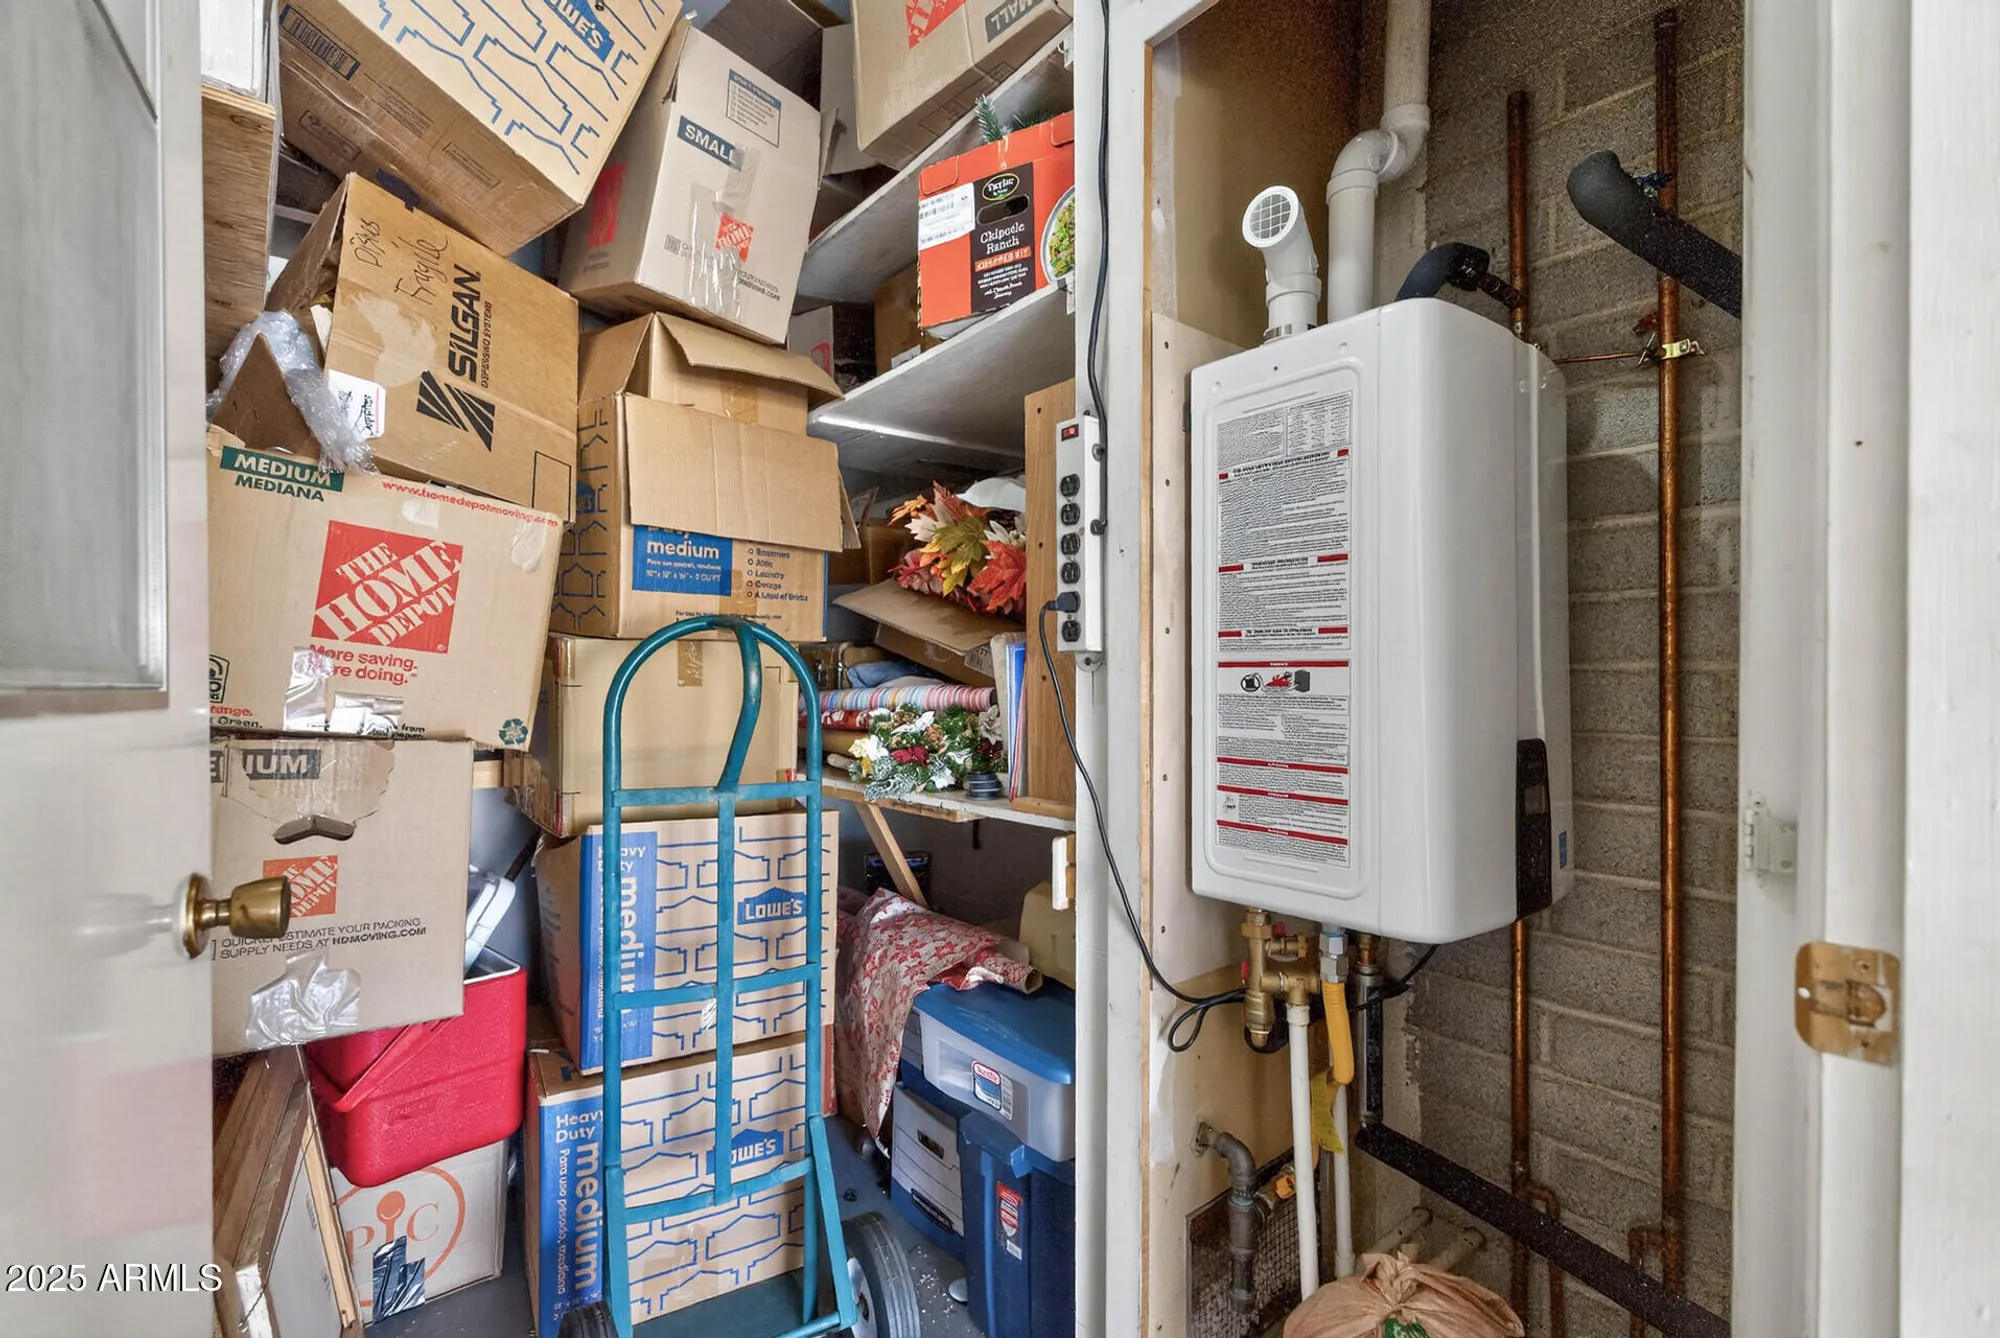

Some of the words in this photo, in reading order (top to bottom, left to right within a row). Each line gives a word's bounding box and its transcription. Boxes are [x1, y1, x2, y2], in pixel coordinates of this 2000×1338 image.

[990, 0, 1035, 31] MALL
[684, 124, 737, 164] SMALL
[986, 235, 1020, 255] Ranch
[448, 263, 481, 383] SILGAN
[233, 453, 332, 486] MEDIUM
[234, 474, 325, 502] MEDIANA
[334, 542, 398, 584] THE
[646, 541, 720, 560] medium
[314, 540, 462, 641] HOME
[368, 584, 456, 646] DEPOT
[309, 644, 355, 662] More
[358, 651, 418, 672] saving.
[355, 665, 408, 686] doing.
[290, 855, 339, 905] OME
[744, 897, 803, 920] LOWE'S
[337, 922, 371, 934] YOUR
[373, 917, 421, 931] PACKING
[221, 945, 269, 960] SUPPLY
[273, 939, 313, 952] NEEDS
[315, 938, 330, 948] AT
[555, 1125, 596, 1144] Duty
[575, 1142, 603, 1289] medium
